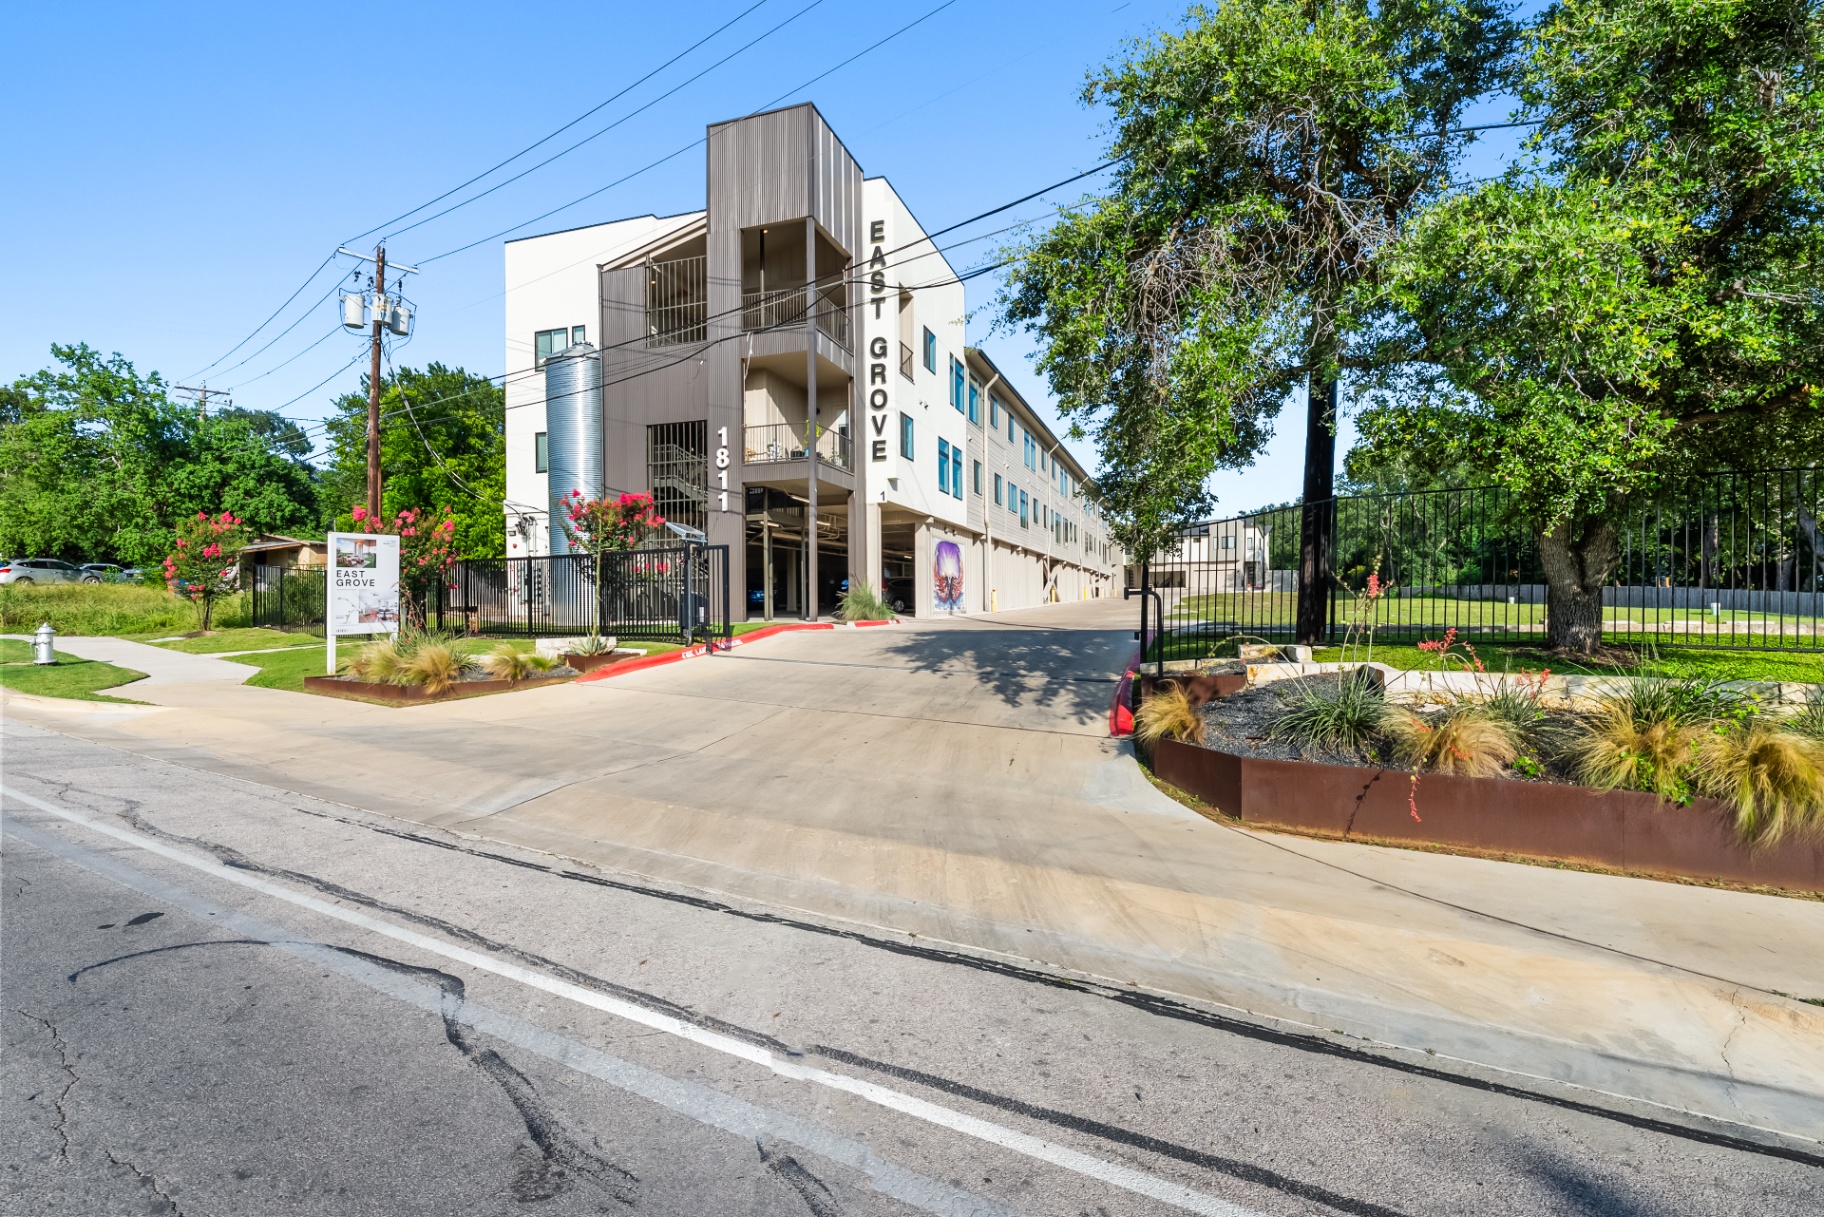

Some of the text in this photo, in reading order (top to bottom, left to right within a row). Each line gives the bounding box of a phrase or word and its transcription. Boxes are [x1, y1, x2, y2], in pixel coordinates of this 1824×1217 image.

[870, 220, 888, 462] EAST GROVE
[716, 427, 730, 512] 1811
[880, 491, 885, 501] 1
[336, 570, 365, 578] EAST
[336, 579, 375, 587] GROVE
